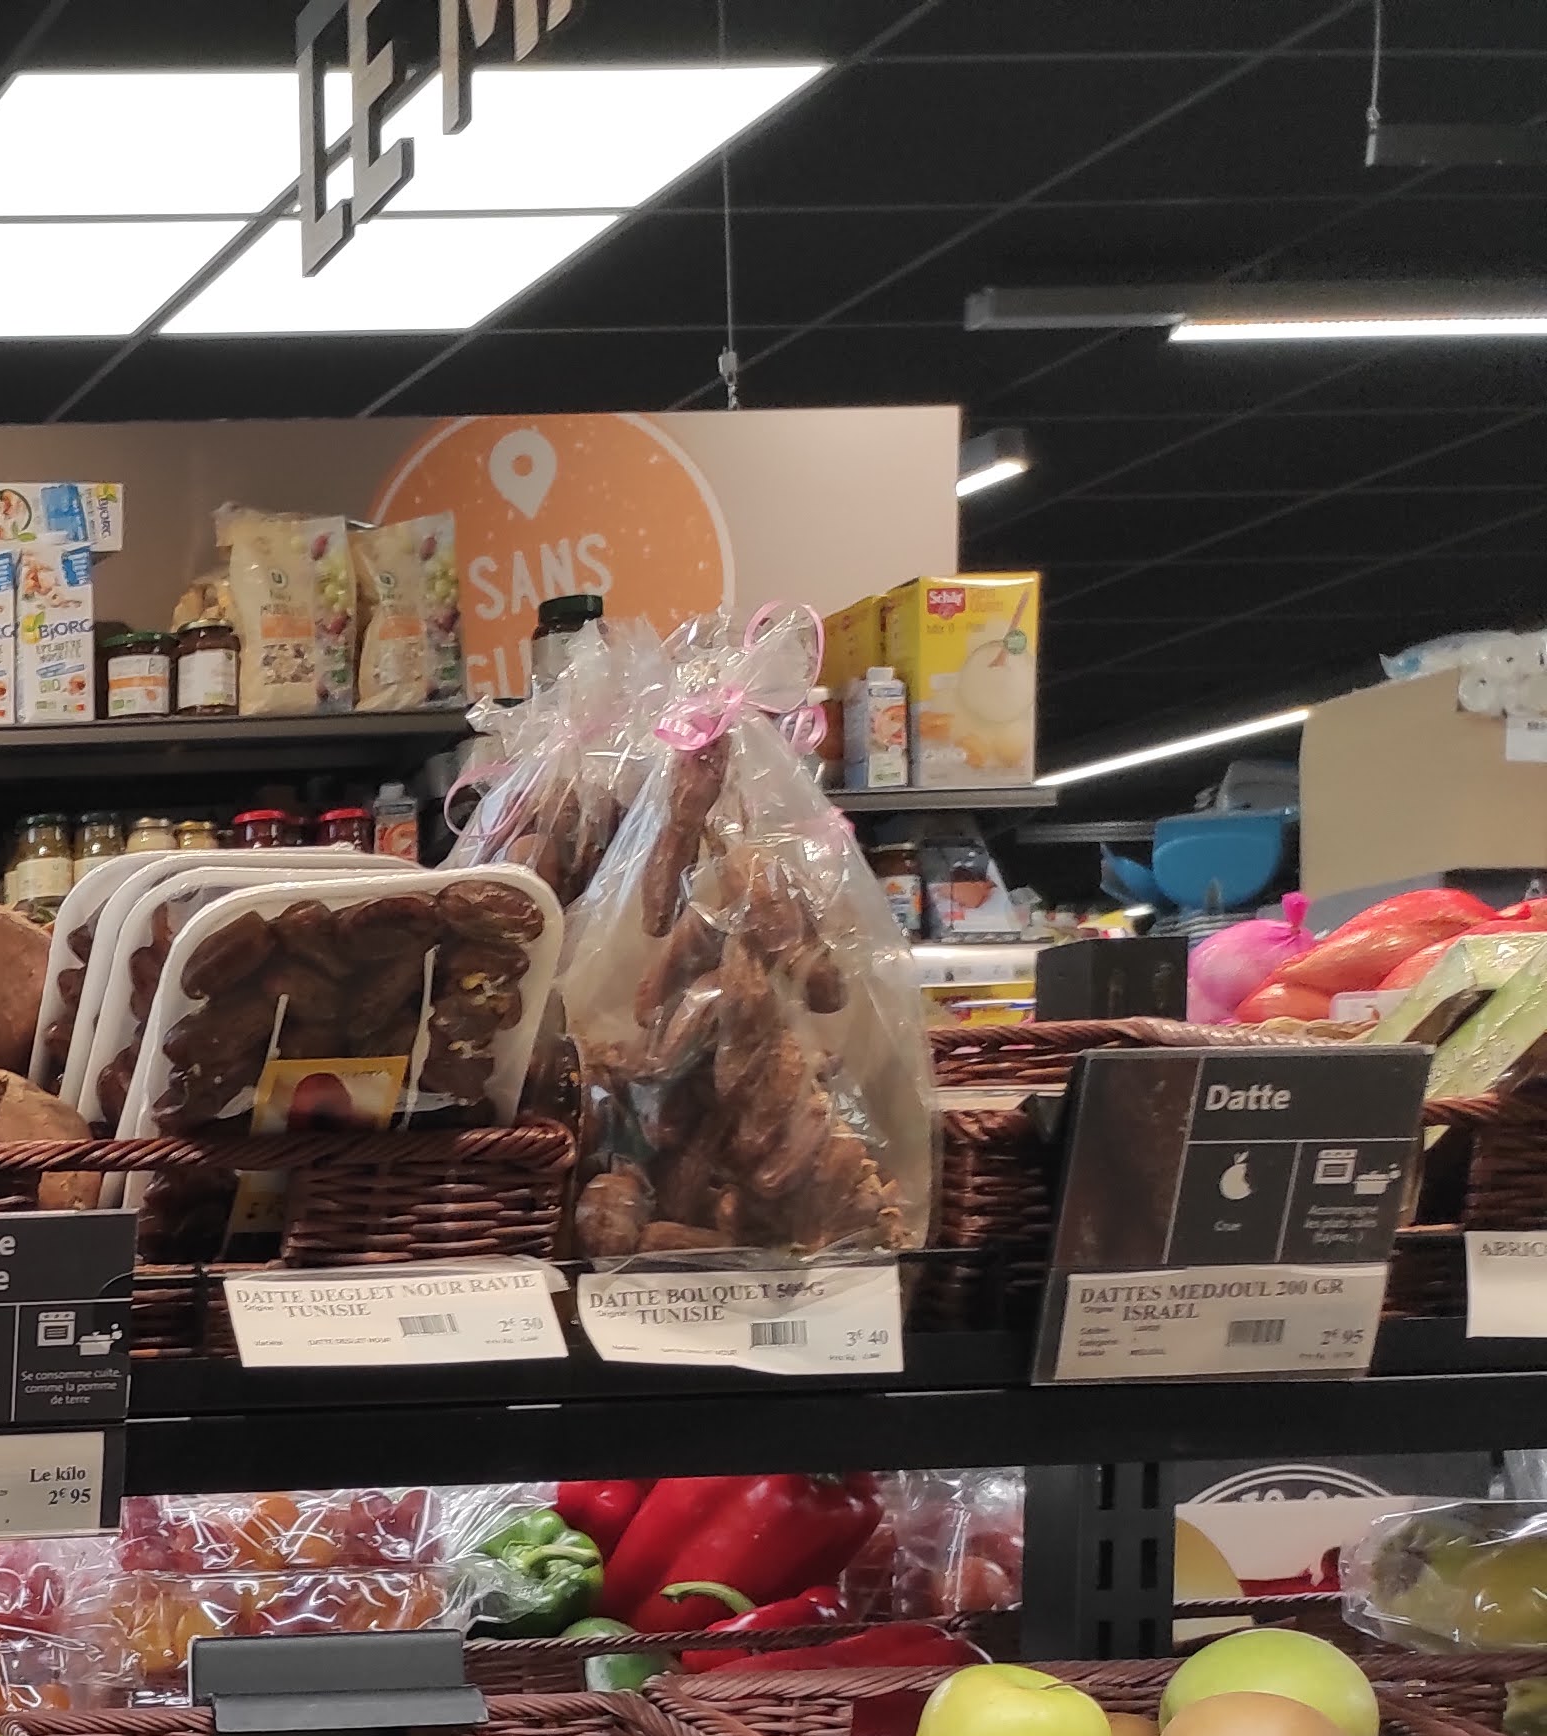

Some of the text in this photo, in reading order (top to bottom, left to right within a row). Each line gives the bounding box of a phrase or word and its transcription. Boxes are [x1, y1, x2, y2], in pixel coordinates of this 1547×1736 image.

[467, 533, 615, 621] SANS
[1204, 1083, 1292, 1112] Datte
[236, 1273, 536, 1304] DATTE DEGLET NOUR RAVIE
[590, 1284, 771, 1309] DATTE BOUQUET
[1079, 1285, 1162, 1305] DATTES
[284, 1303, 372, 1318] TUNISIE
[635, 1305, 725, 1326] TUNISIE
[1122, 1303, 1199, 1322] ISRAEL
[24, 1380, 118, 1394] comme la pomme
[50, 1394, 91, 1405] de terre
[30, 1466, 87, 1483] Le kilo
